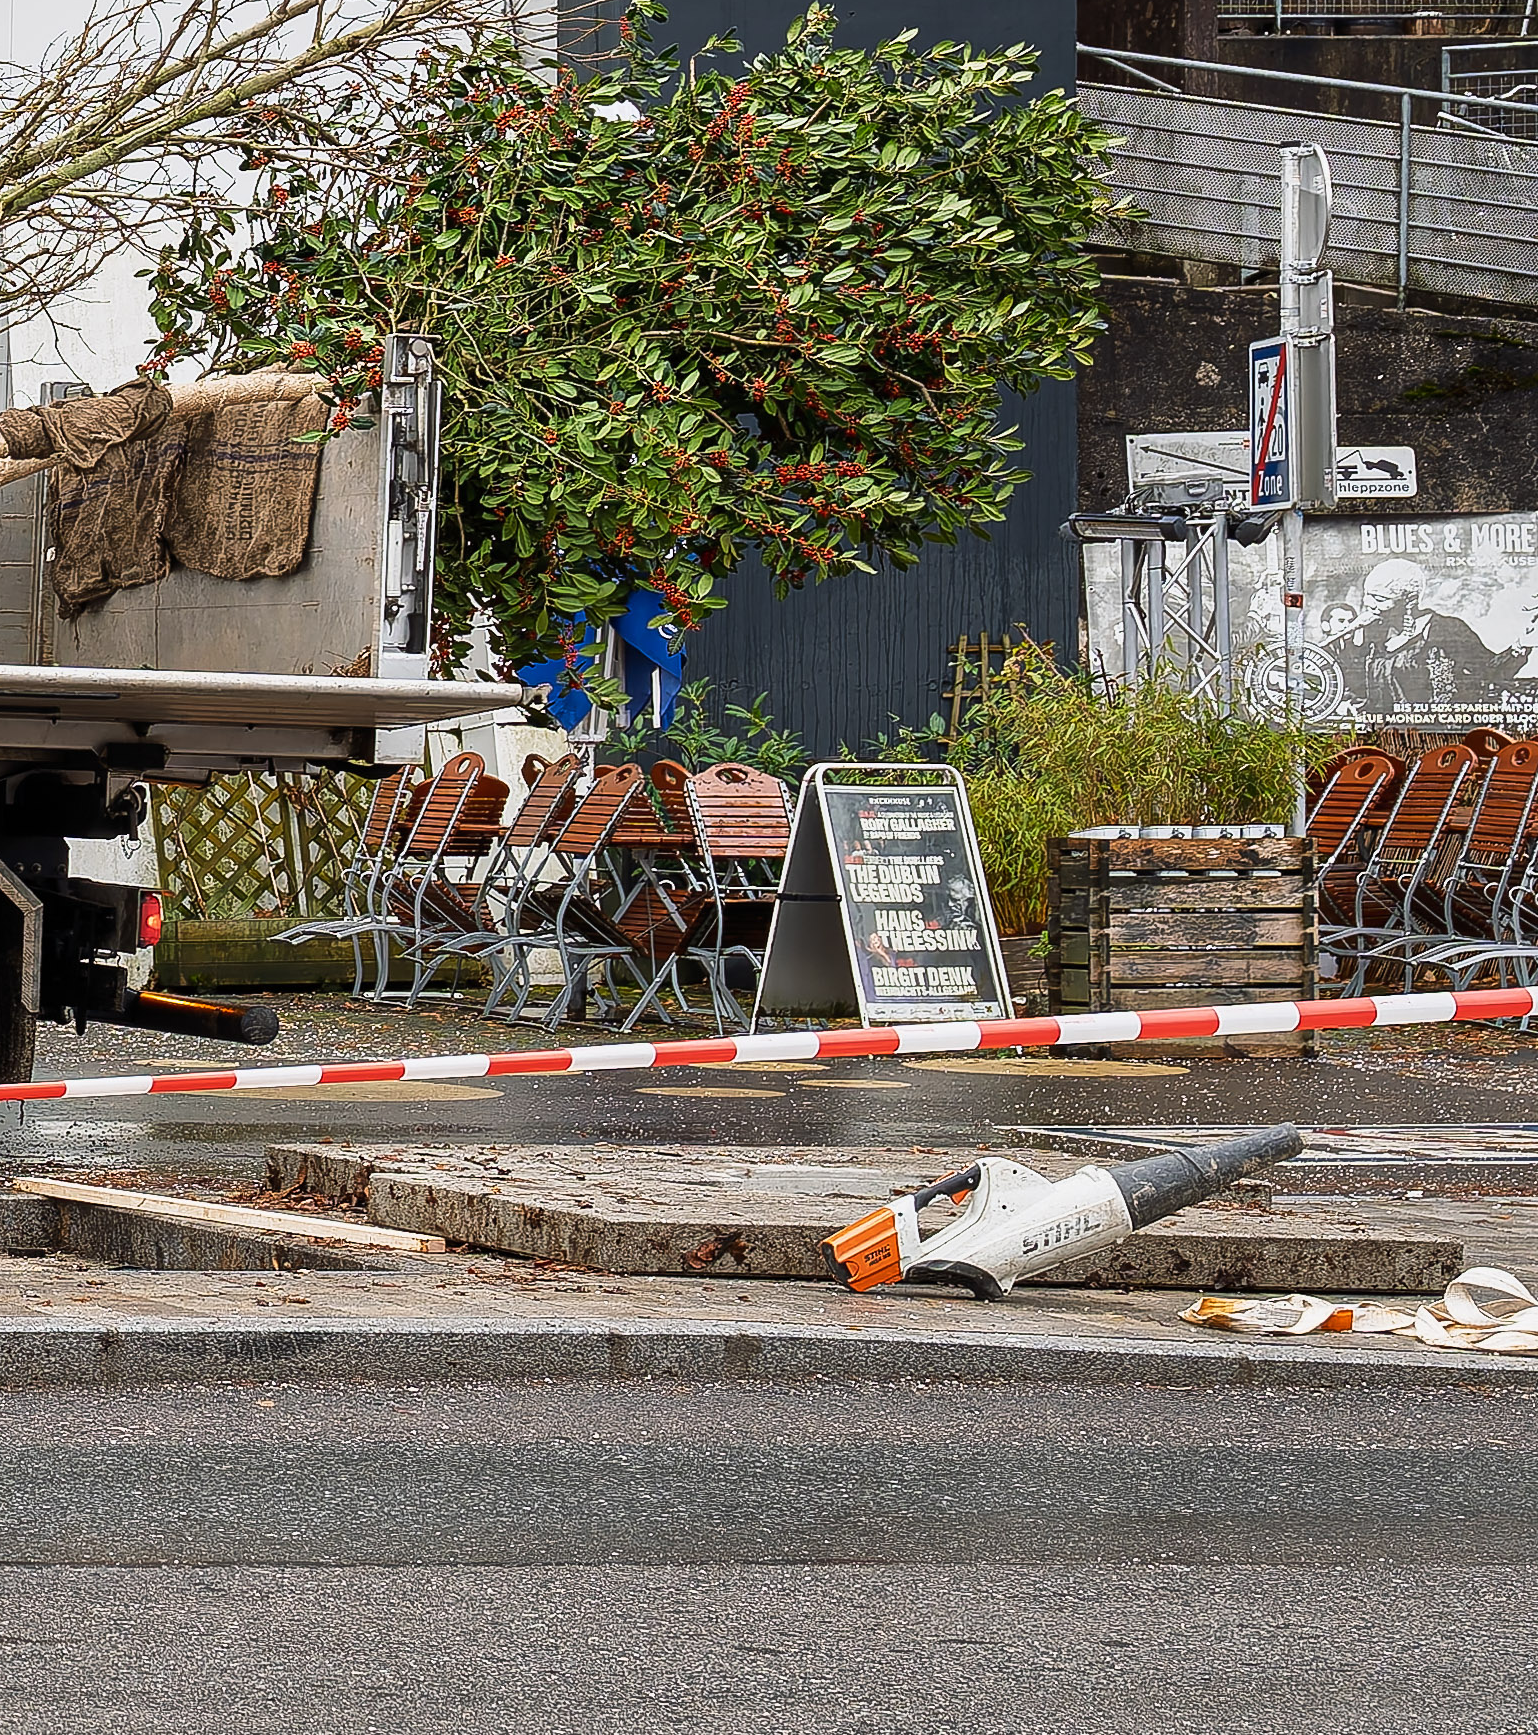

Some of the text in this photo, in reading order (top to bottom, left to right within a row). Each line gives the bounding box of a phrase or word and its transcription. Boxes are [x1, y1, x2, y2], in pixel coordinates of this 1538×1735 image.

[1258, 470, 1283, 498] Zone
[1339, 481, 1410, 495] hleppzone
[1361, 523, 1536, 554] BLUES & MORE
[1393, 703, 1412, 713] BIS
[1414, 703, 1429, 713] ZU
[1453, 703, 1498, 713] SPAREN
[1386, 714, 1437, 724] MONDAY
[1439, 714, 1472, 724] CARD
[860, 817, 956, 832] RORY GALLAGHER
[845, 865, 941, 884] THE DUBLIN
[849, 883, 924, 903] LEGENDS
[874, 909, 926, 931] HANS
[877, 929, 982, 952] THEESSINK
[871, 966, 976, 987] BIRGIT DENK
[864, 1243, 891, 1263] STIHL
